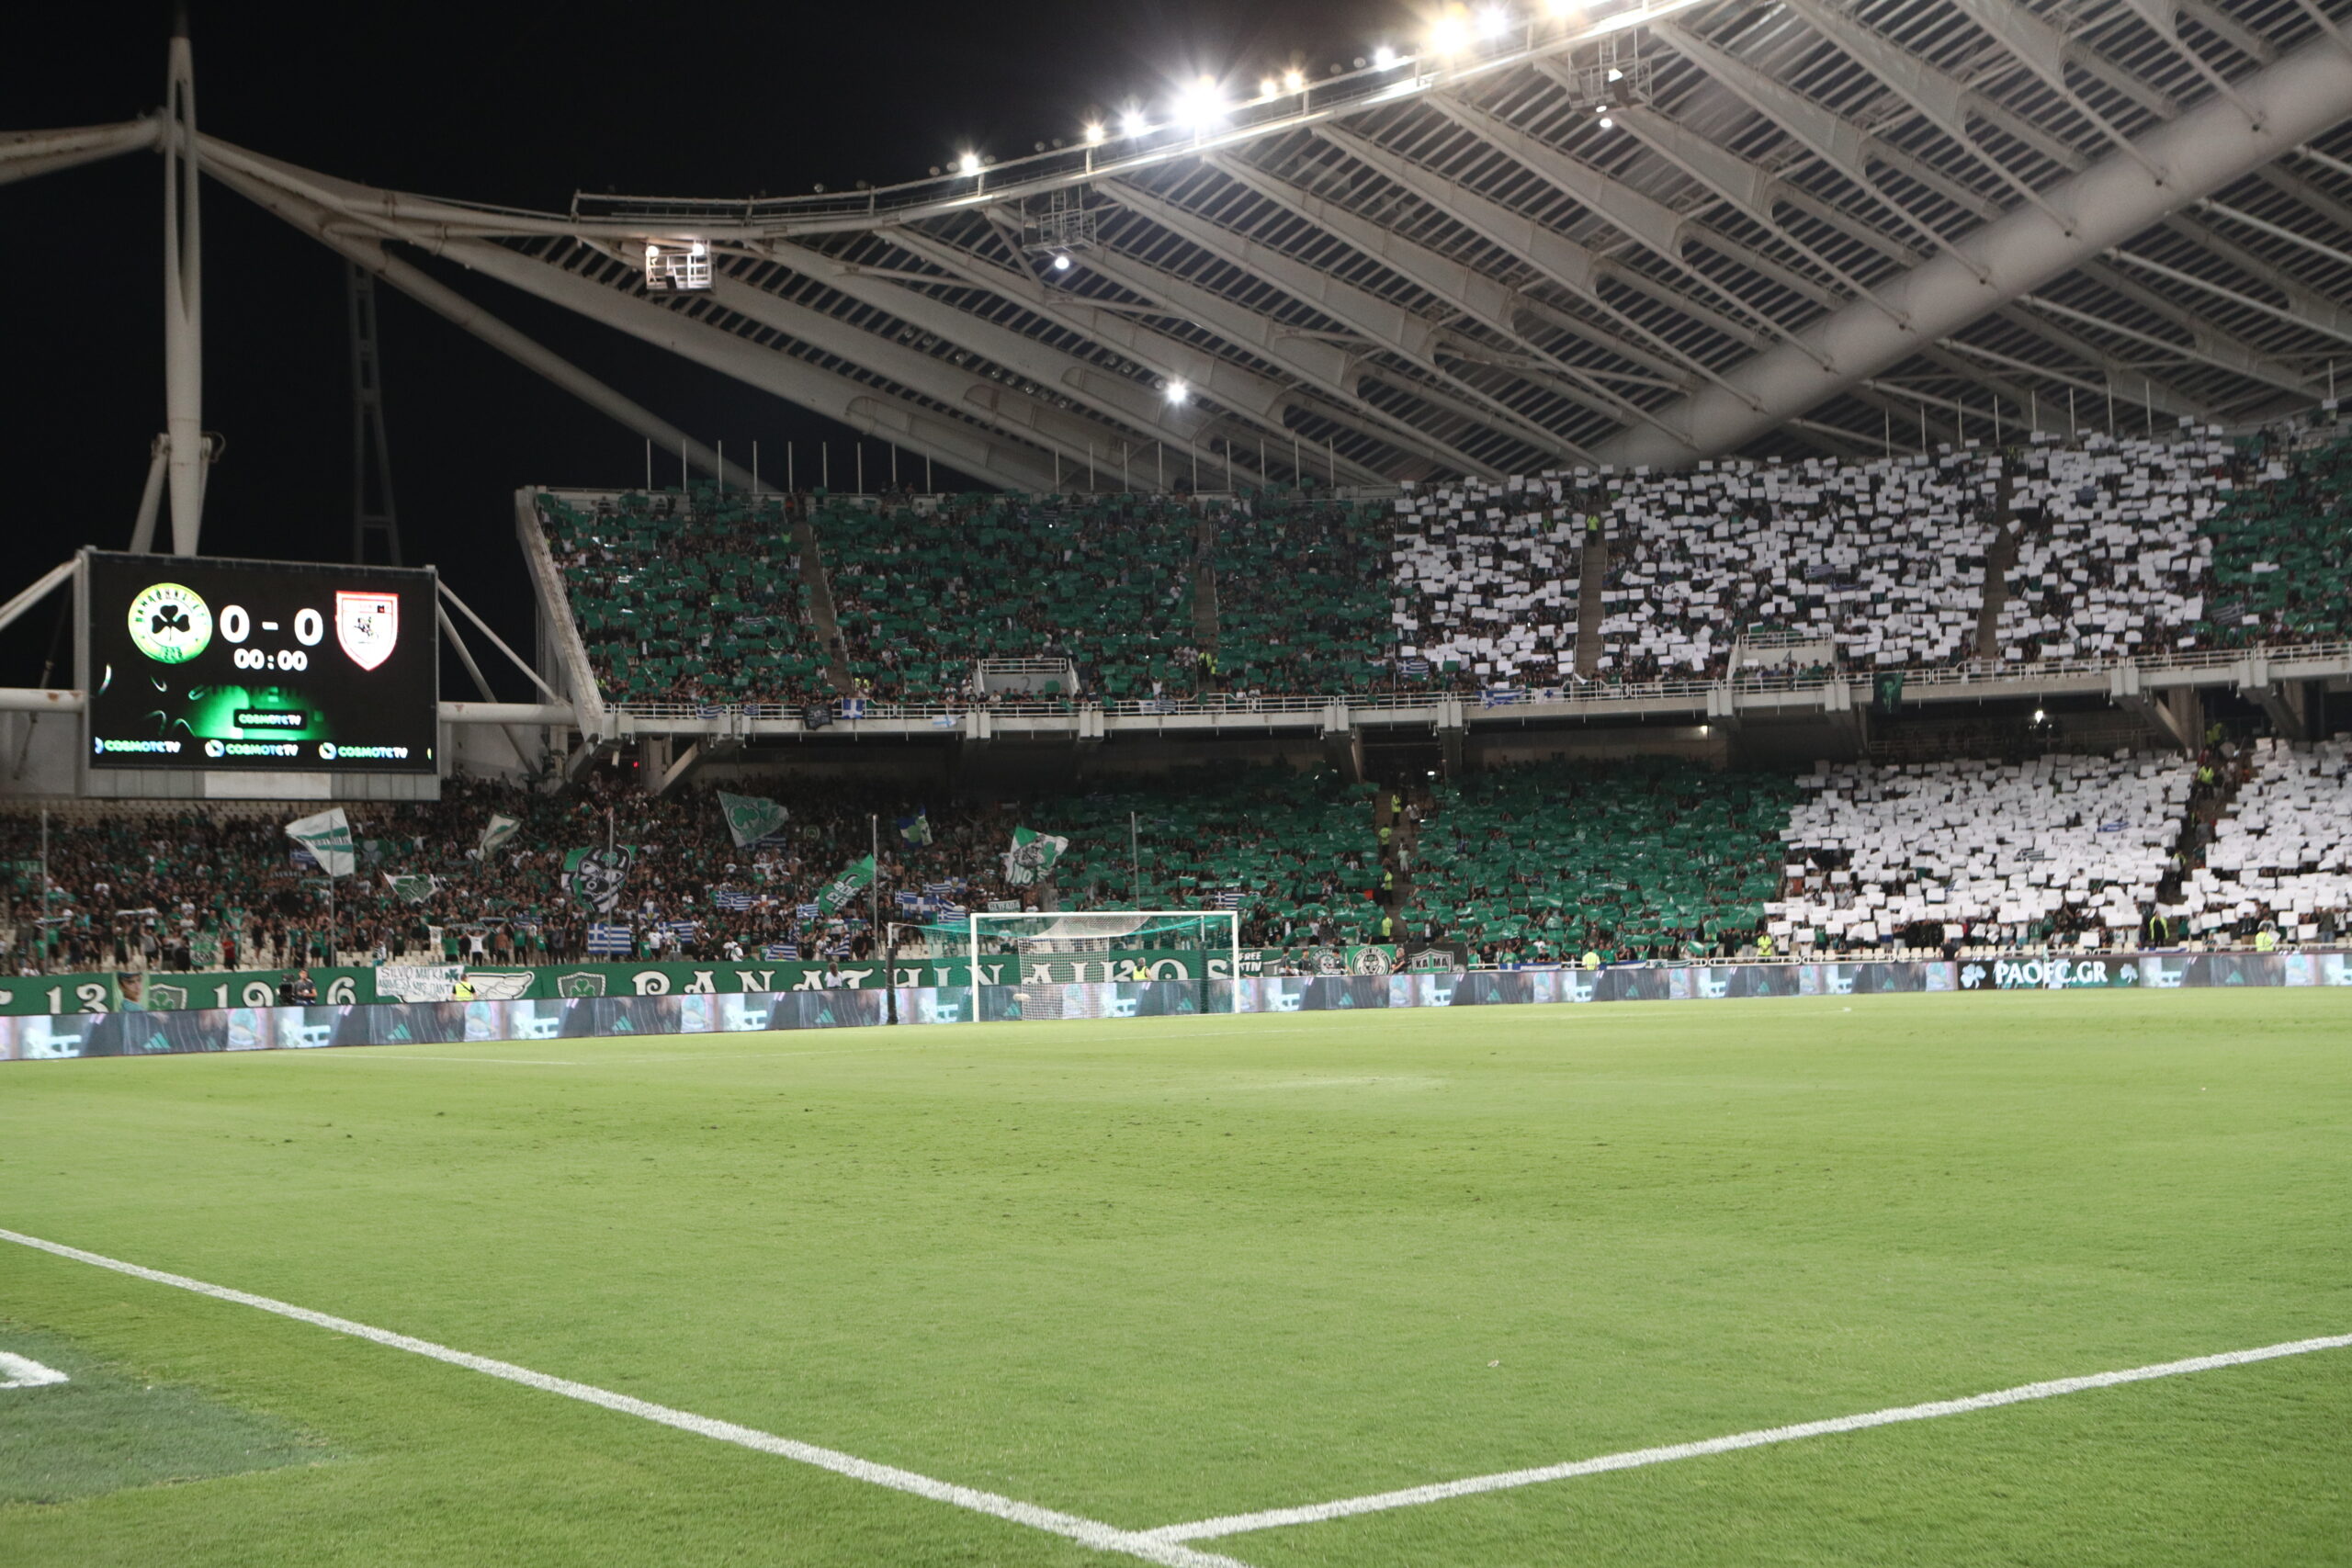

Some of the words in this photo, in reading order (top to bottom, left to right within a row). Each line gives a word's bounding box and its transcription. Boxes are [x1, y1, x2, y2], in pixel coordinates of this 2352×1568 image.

[220, 604, 251, 644] 0
[293, 607, 324, 647] 0
[233, 649, 309, 671] 00:00
[1238, 951, 1262, 961] FREE
[1995, 961, 2109, 984] PAOFC.GR
[45, 982, 110, 1014] 13
[212, 975, 358, 1009] 196
